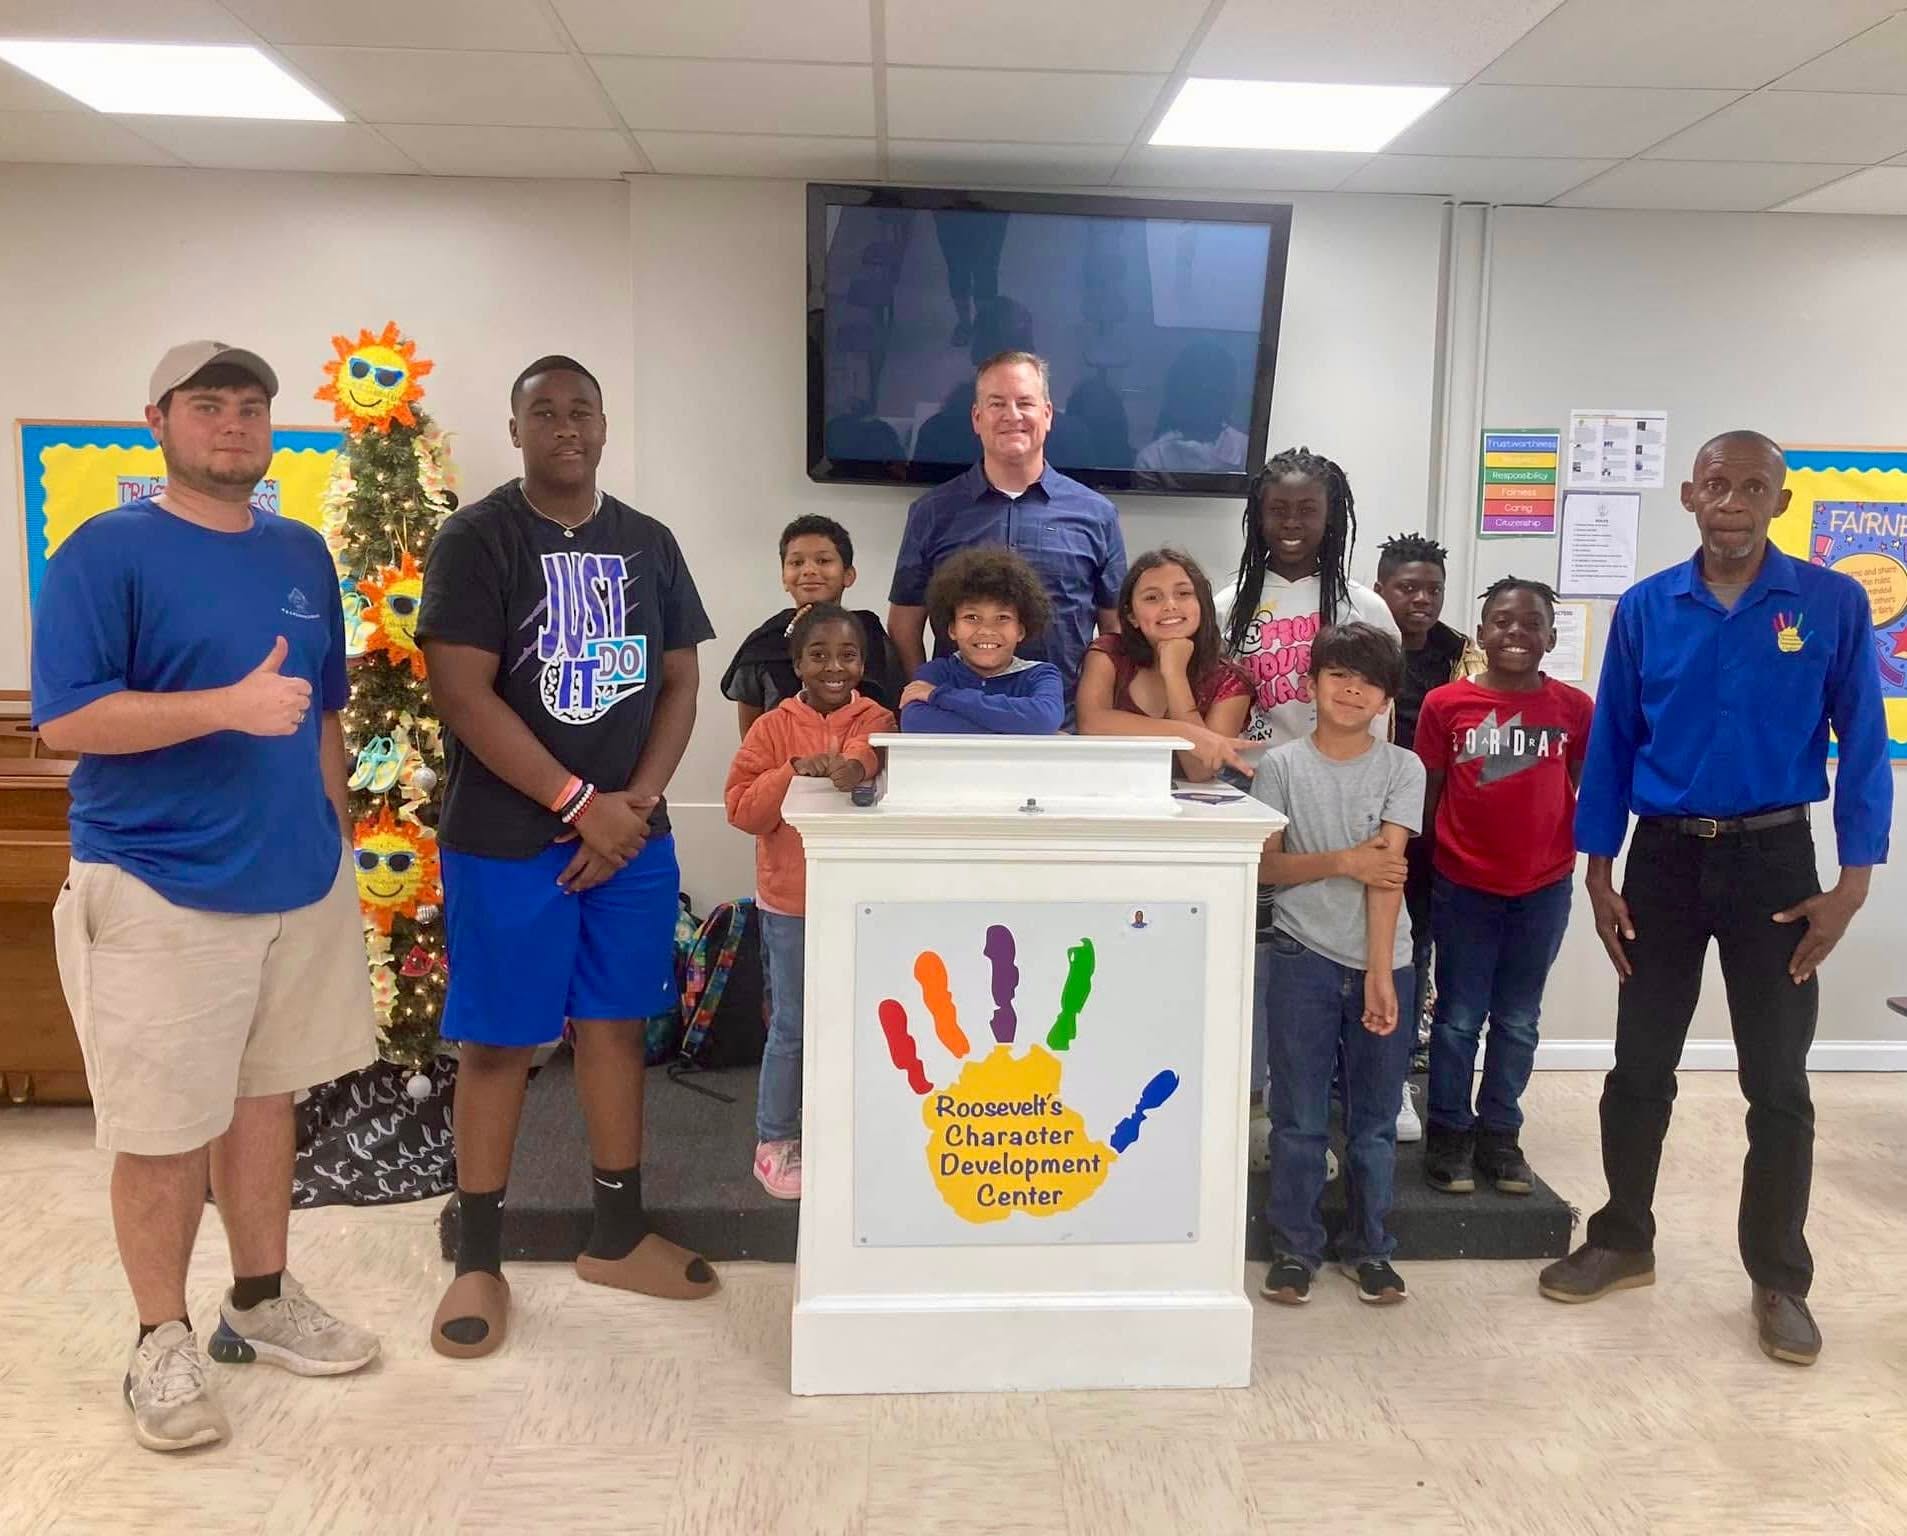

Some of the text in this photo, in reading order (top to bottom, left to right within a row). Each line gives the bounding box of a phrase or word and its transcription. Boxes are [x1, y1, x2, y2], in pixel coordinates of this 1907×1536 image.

[1492, 471, 1548, 481] Responsibility
[1501, 487, 1537, 497] Fairness
[1504, 503, 1533, 514] Caring
[1495, 518, 1541, 528] Citizenship
[538, 552, 628, 663] JUST
[597, 642, 643, 681] DO
[555, 658, 601, 711] IT
[936, 1093, 1063, 1118] Roosevelt's
[945, 1125, 1075, 1147] Character
[940, 1152, 1101, 1181] Development
[976, 1183, 1063, 1207] Center
